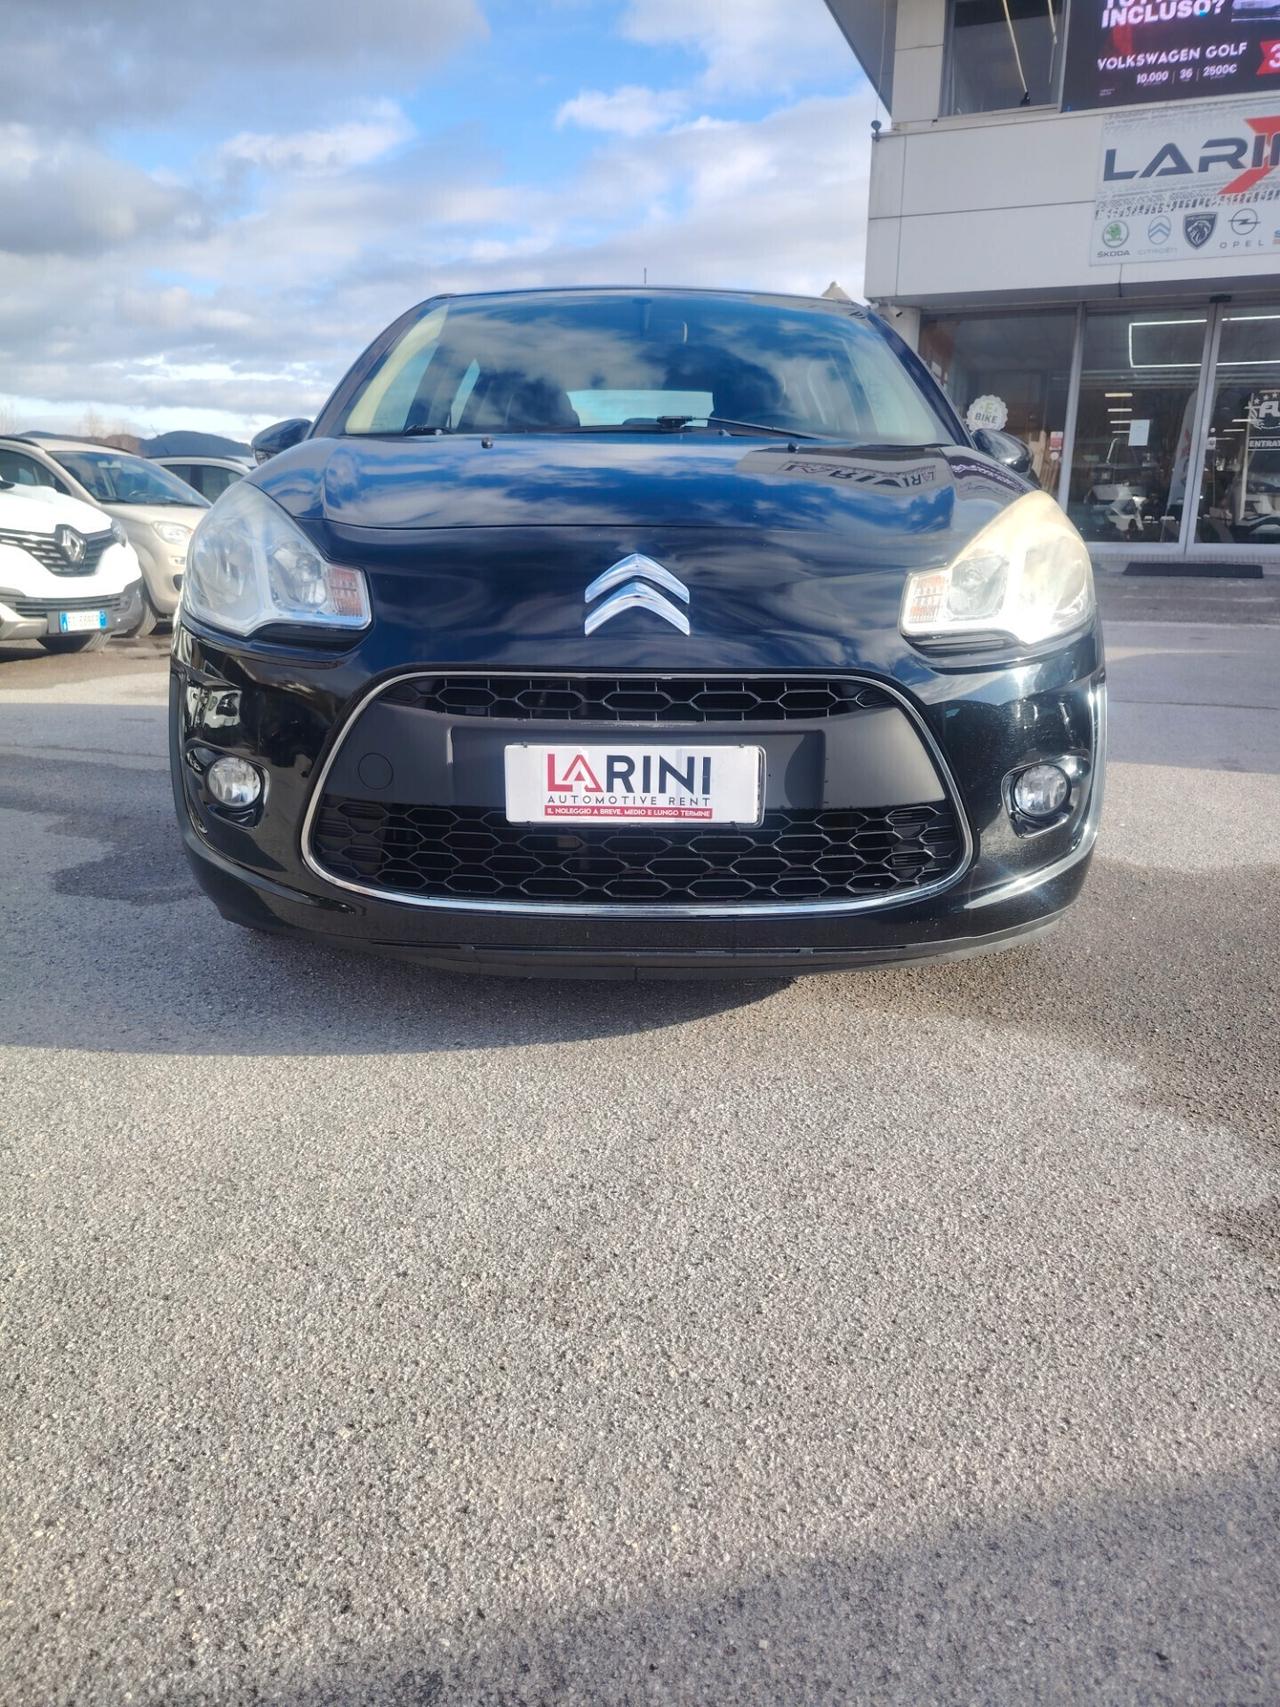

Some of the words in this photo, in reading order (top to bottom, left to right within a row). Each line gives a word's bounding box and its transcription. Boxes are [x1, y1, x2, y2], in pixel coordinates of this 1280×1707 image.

[1101, 0, 1226, 28] INCLUSO?
[1097, 47, 1201, 71] VOLKSWAGEN
[1206, 42, 1248, 59] GOLF
[1103, 133, 1280, 182] LARI
[1219, 239, 1264, 249] OPEL
[974, 413, 999, 424] BIKE
[547, 753, 712, 794] LARINI
[547, 795, 657, 806] AUTOMOTIVE
[669, 796, 711, 807] RENT
[547, 807, 554, 815] IL
[555, 807, 592, 815] NOLEGGIO
[624, 808, 646, 816] MEDIO
[654, 809, 679, 817] LUNGO
[680, 809, 711, 818] TERMINE
